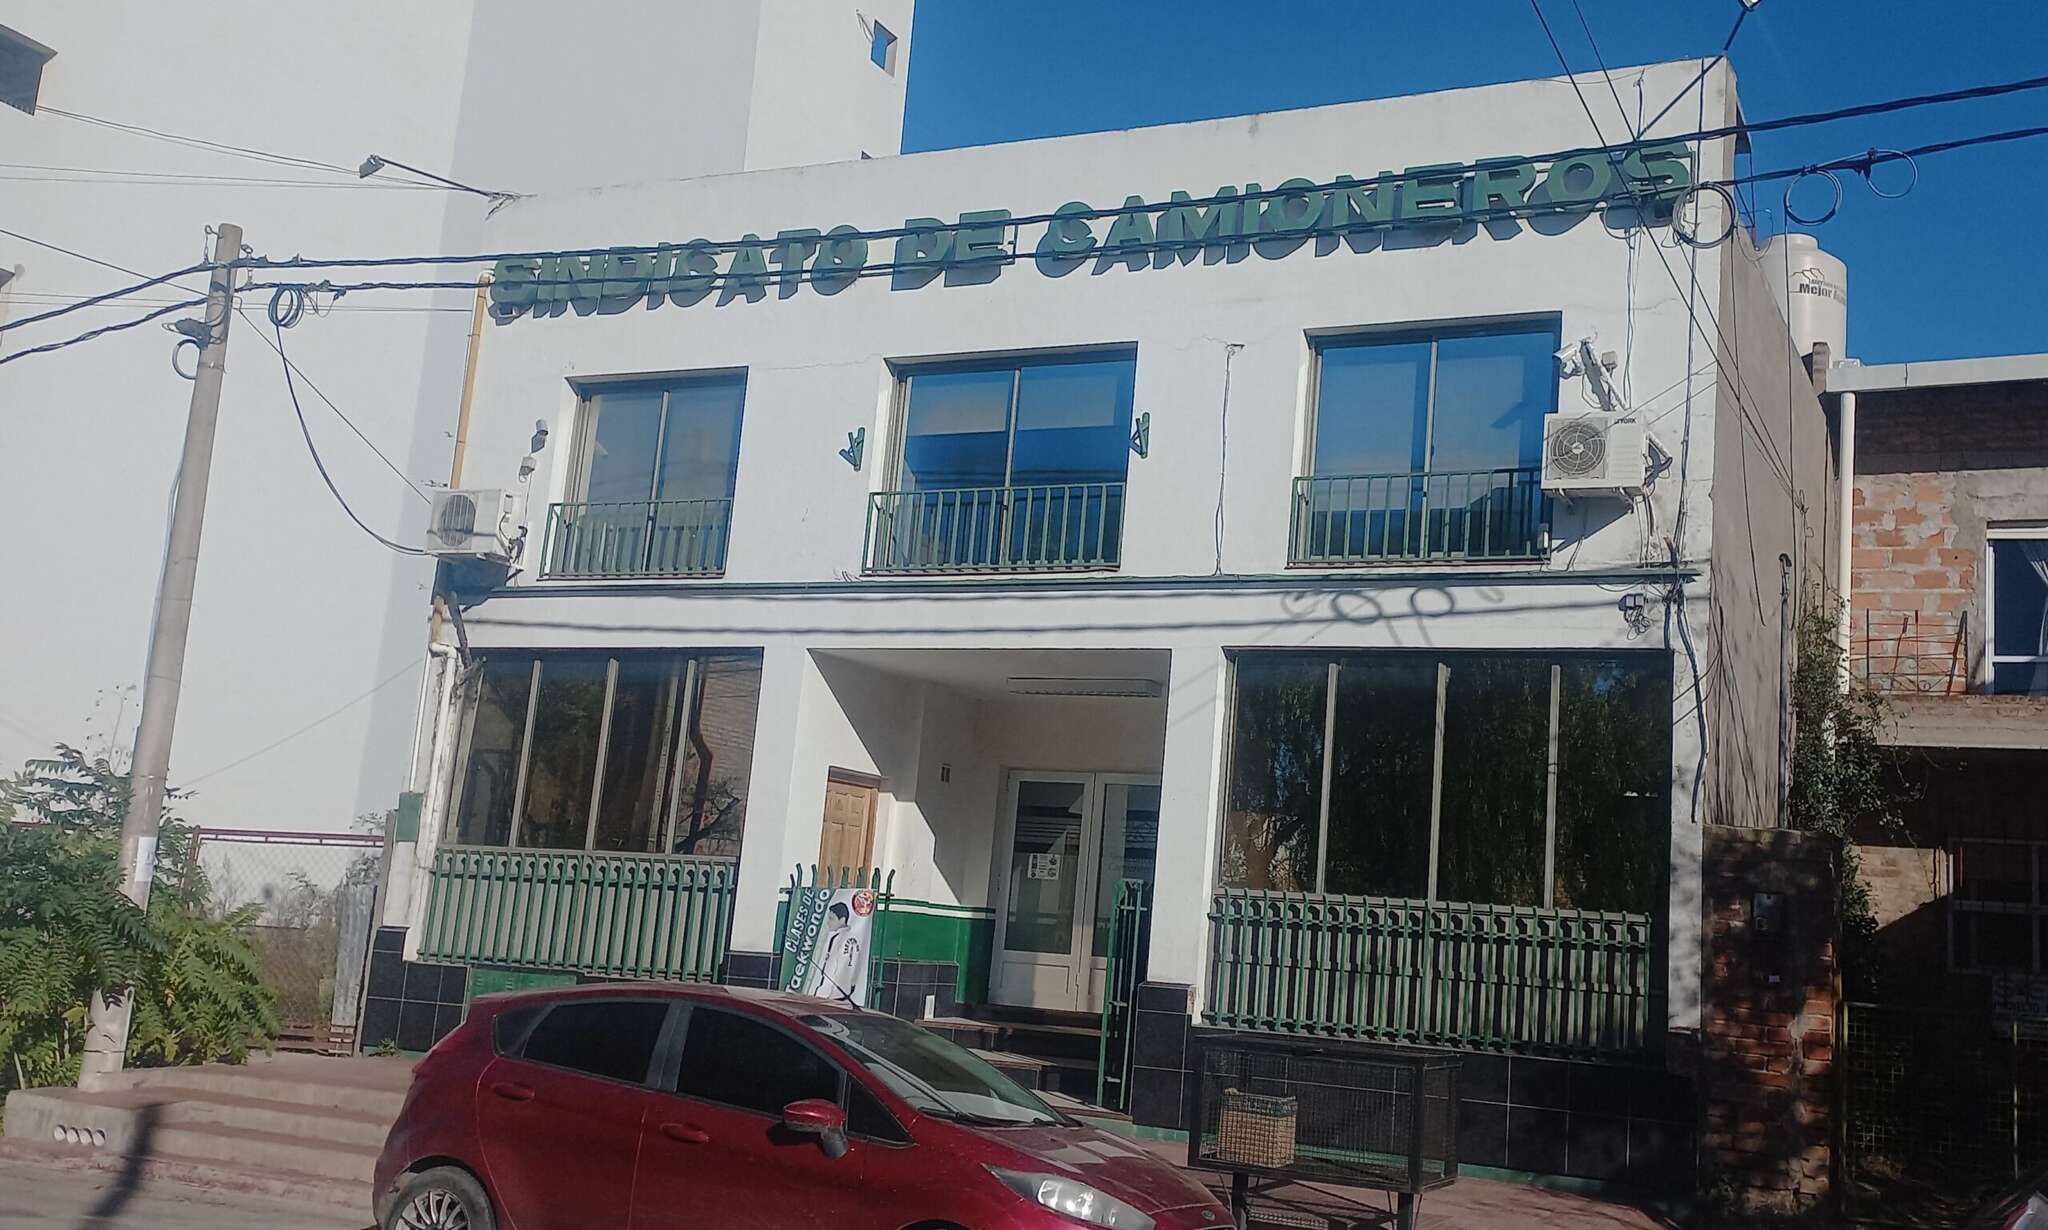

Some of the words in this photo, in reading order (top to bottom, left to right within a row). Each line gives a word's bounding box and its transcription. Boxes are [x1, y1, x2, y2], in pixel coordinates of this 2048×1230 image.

[489, 223, 869, 304] SINDICATO
[896, 210, 1012, 276] DE
[1047, 140, 1691, 256] CAMIONEROS
[785, 904, 809, 953] CLASES
[803, 887, 815, 907] DE
